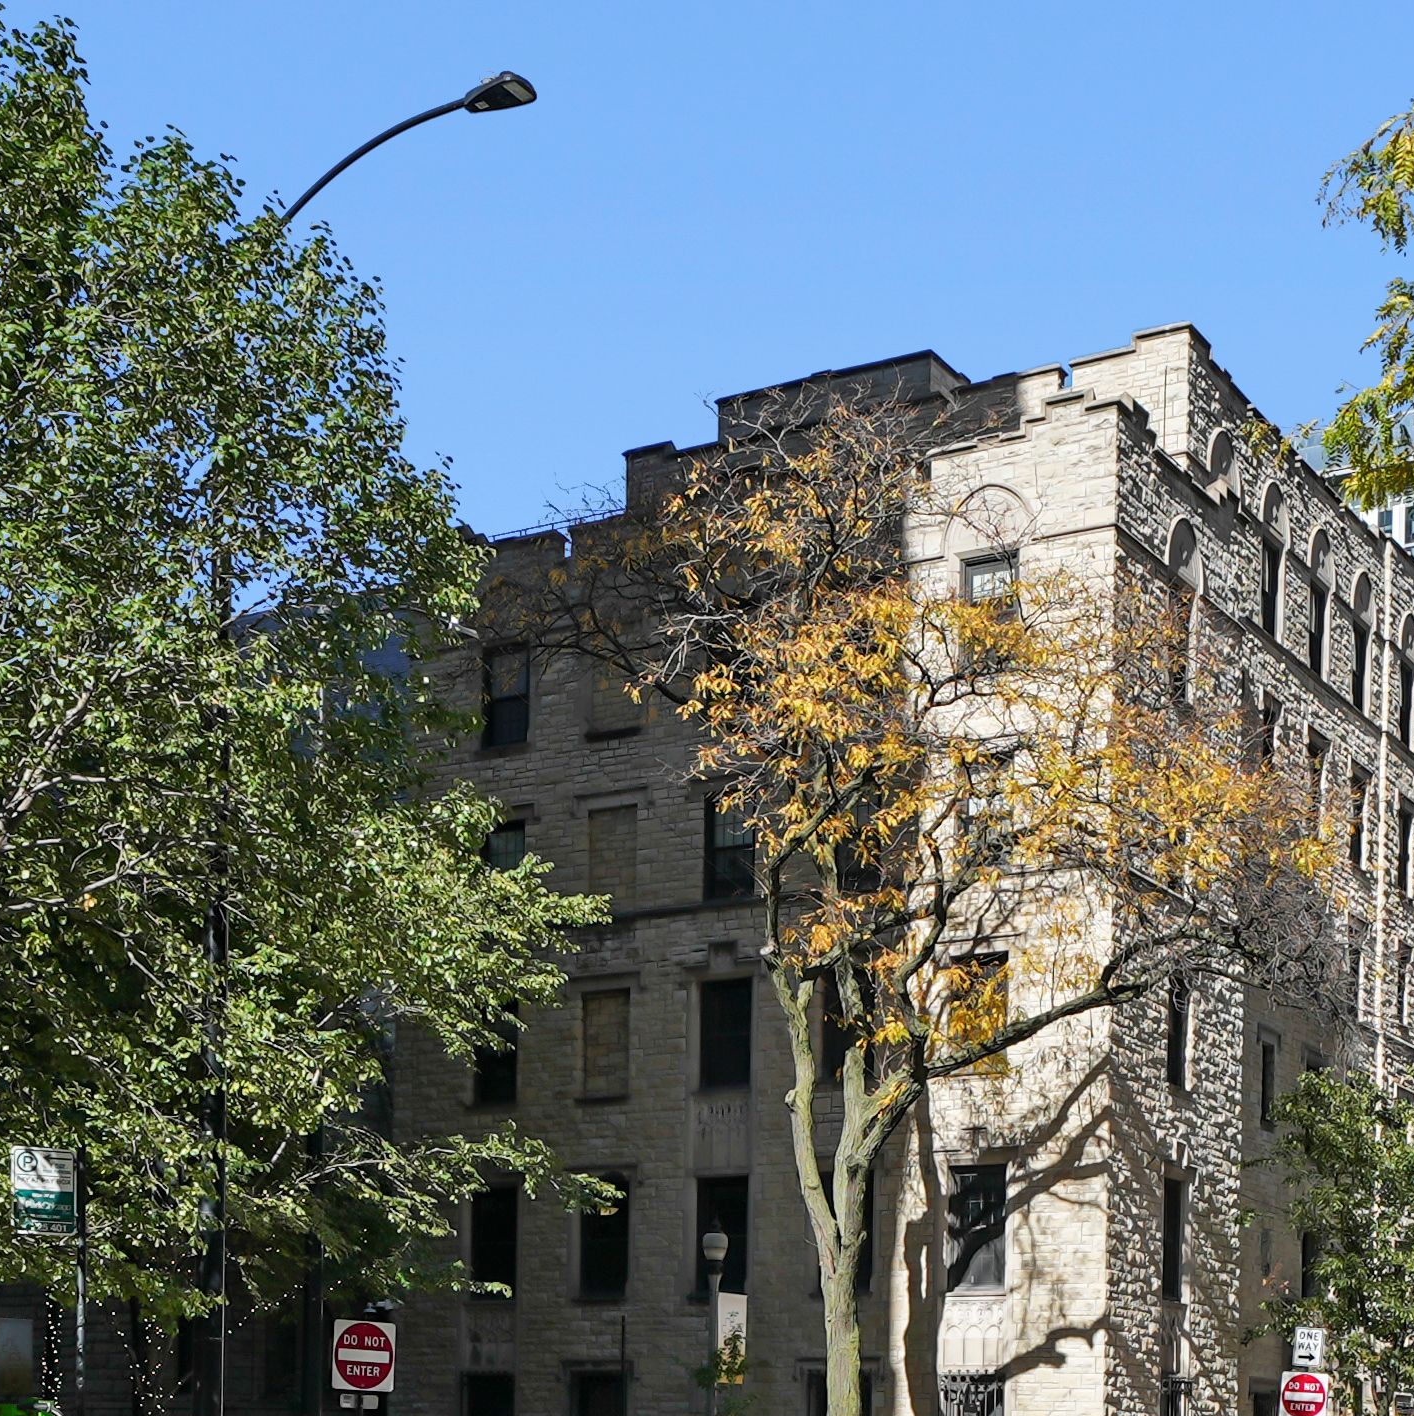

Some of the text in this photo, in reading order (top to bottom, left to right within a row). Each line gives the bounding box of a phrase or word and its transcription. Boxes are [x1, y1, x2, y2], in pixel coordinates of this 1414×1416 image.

[343, 1334, 386, 1348] DO NOT
[1299, 1331, 1320, 1341] ONE
[1298, 1341, 1319, 1351] WAY
[346, 1364, 380, 1377] ENTER
[1288, 1381, 1321, 1392] DO NOT
[1289, 1402, 1316, 1412] ENTER
